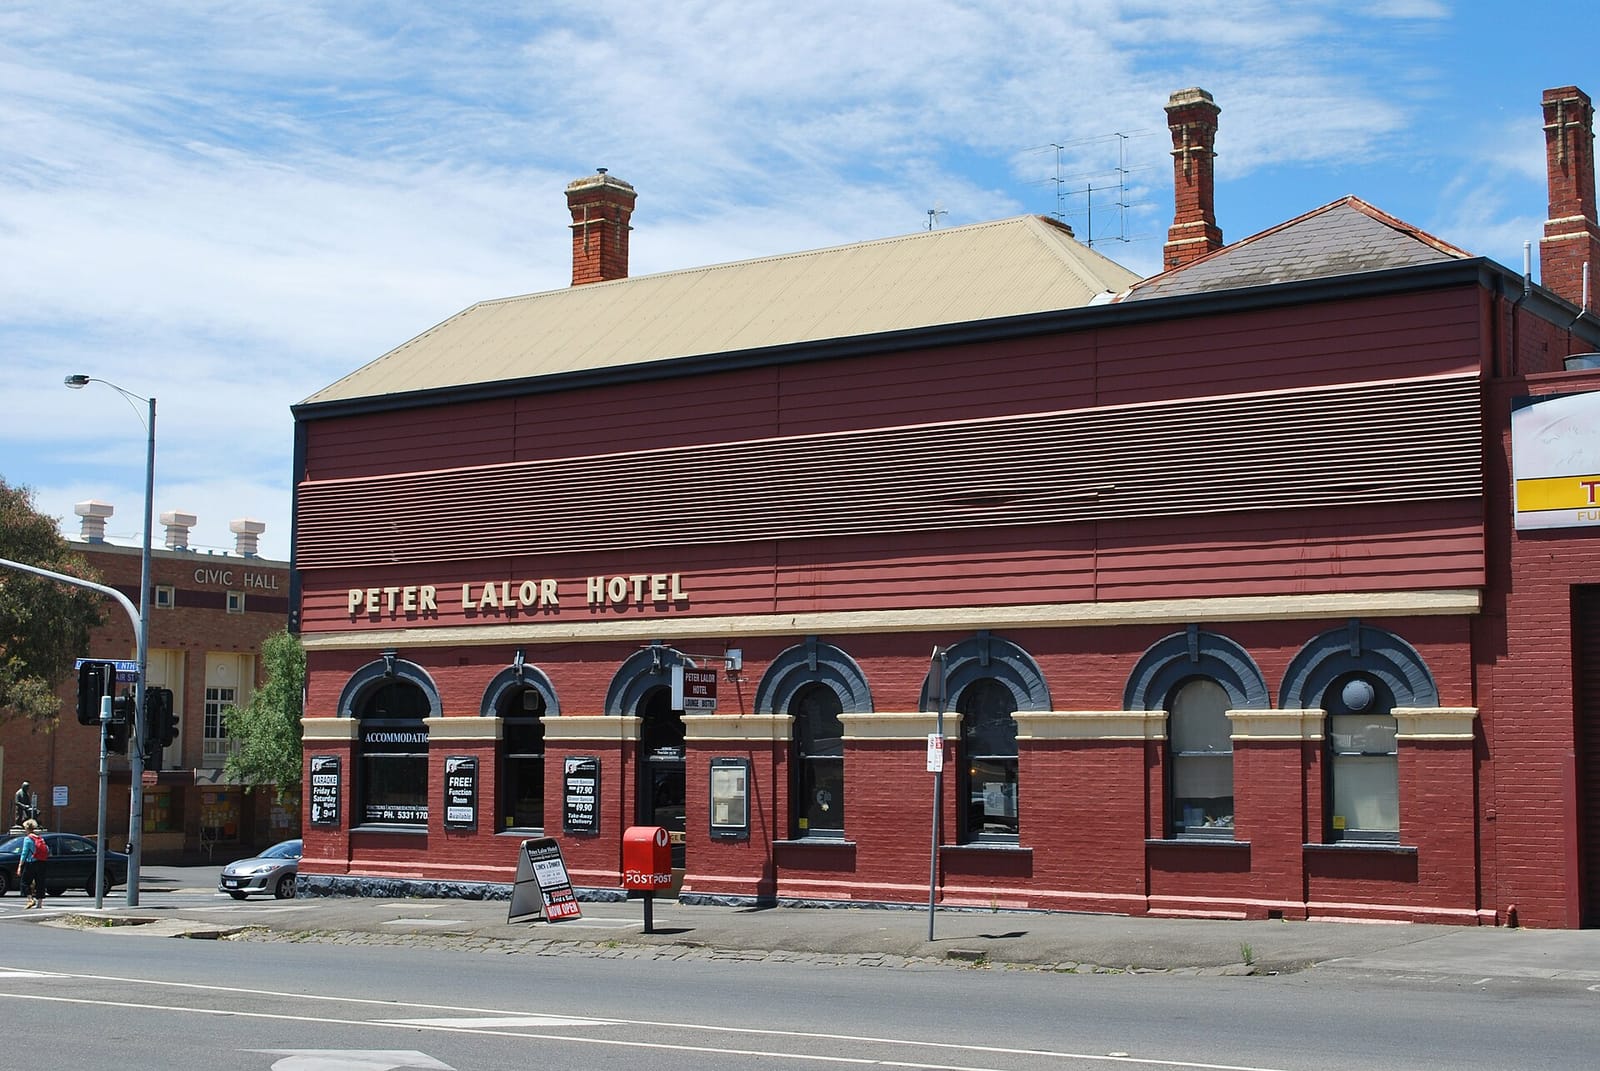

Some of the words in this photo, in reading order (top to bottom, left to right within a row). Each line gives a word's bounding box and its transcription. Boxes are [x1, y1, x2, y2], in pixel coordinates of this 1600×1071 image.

[1577, 511, 1600, 520] FU
[194, 568, 233, 586] CIVIC
[244, 572, 278, 590] HALL
[348, 585, 438, 614] PETER
[462, 579, 560, 609] LALOR
[587, 573, 689, 603] HOTEL
[685, 673, 699, 682] PETER
[700, 674, 715, 683] LALOR
[693, 686, 707, 694] HOTEL
[449, 777, 472, 787] FREE!
[314, 787, 330, 795] Friday
[626, 874, 653, 884] POST
[654, 874, 672, 884] POST
[562, 901, 578, 914] OPEN
